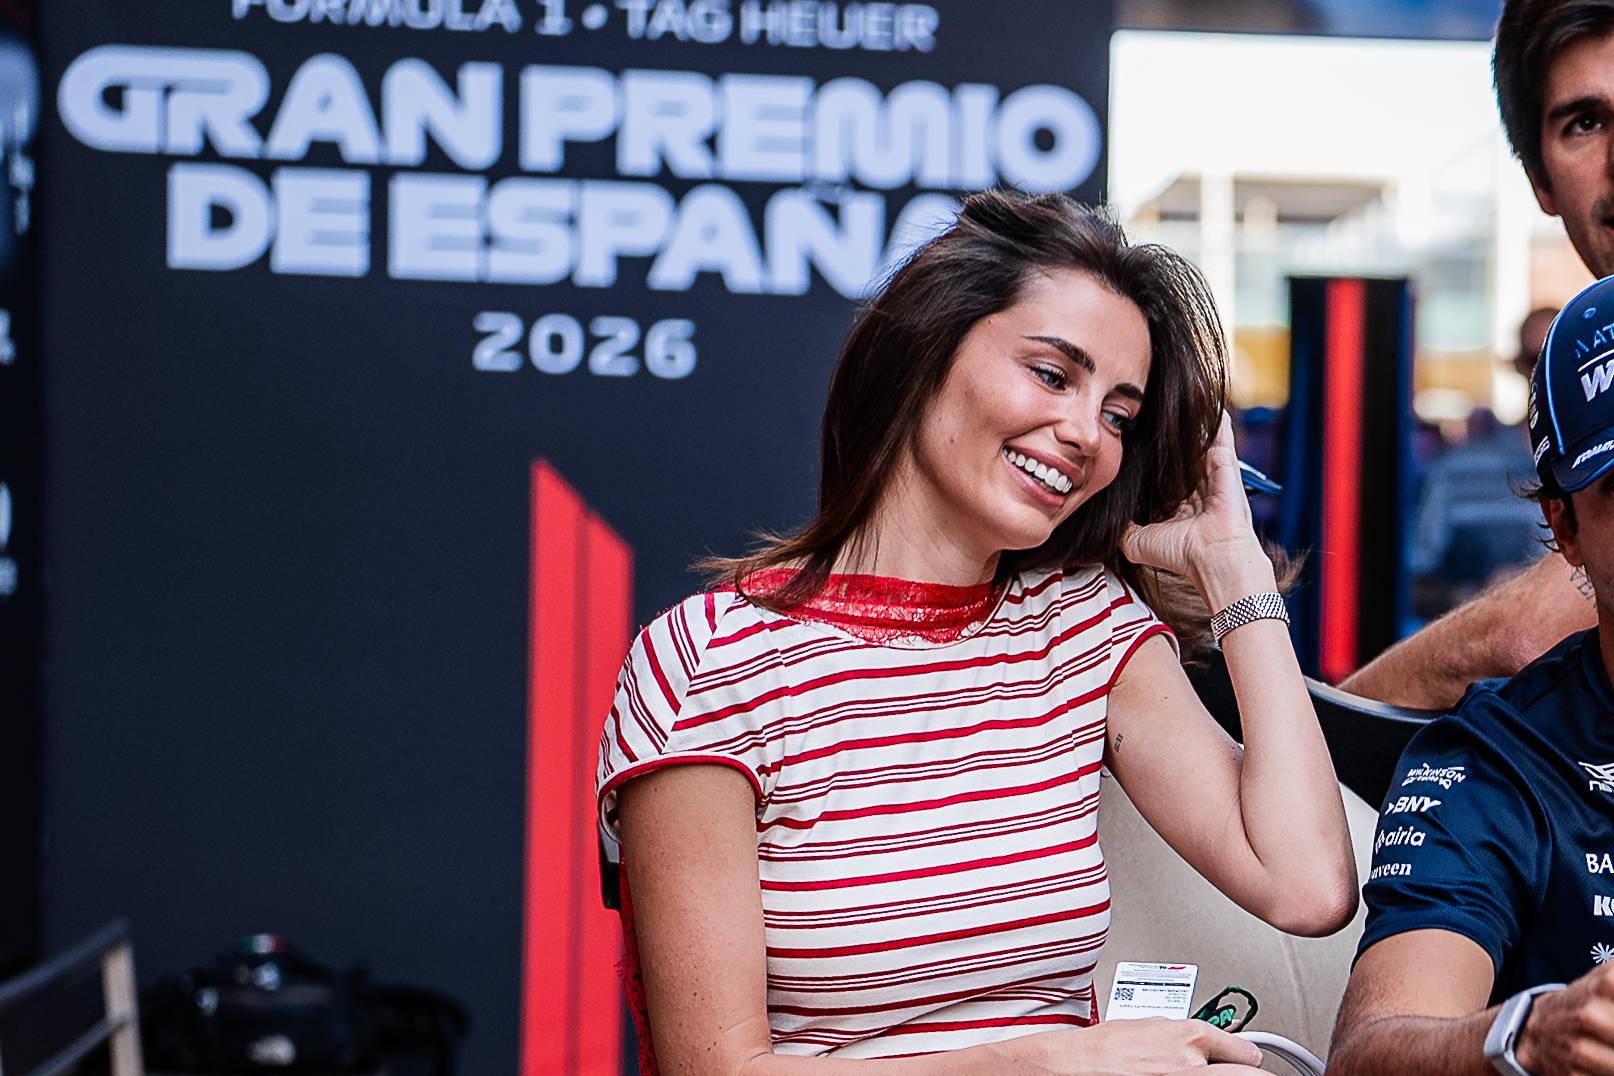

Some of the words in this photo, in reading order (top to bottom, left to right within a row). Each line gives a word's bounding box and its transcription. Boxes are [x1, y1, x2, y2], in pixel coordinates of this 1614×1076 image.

[536, 0, 573, 36] 1
[615, 0, 733, 44] TAG
[740, 0, 940, 52] HEUER
[56, 45, 503, 170] GRAN
[519, 64, 1102, 193] PREMIO
[166, 161, 371, 277] DE
[472, 311, 697, 380] 2026
[1392, 795, 1441, 814] BNY
[1385, 825, 1426, 847] airia
